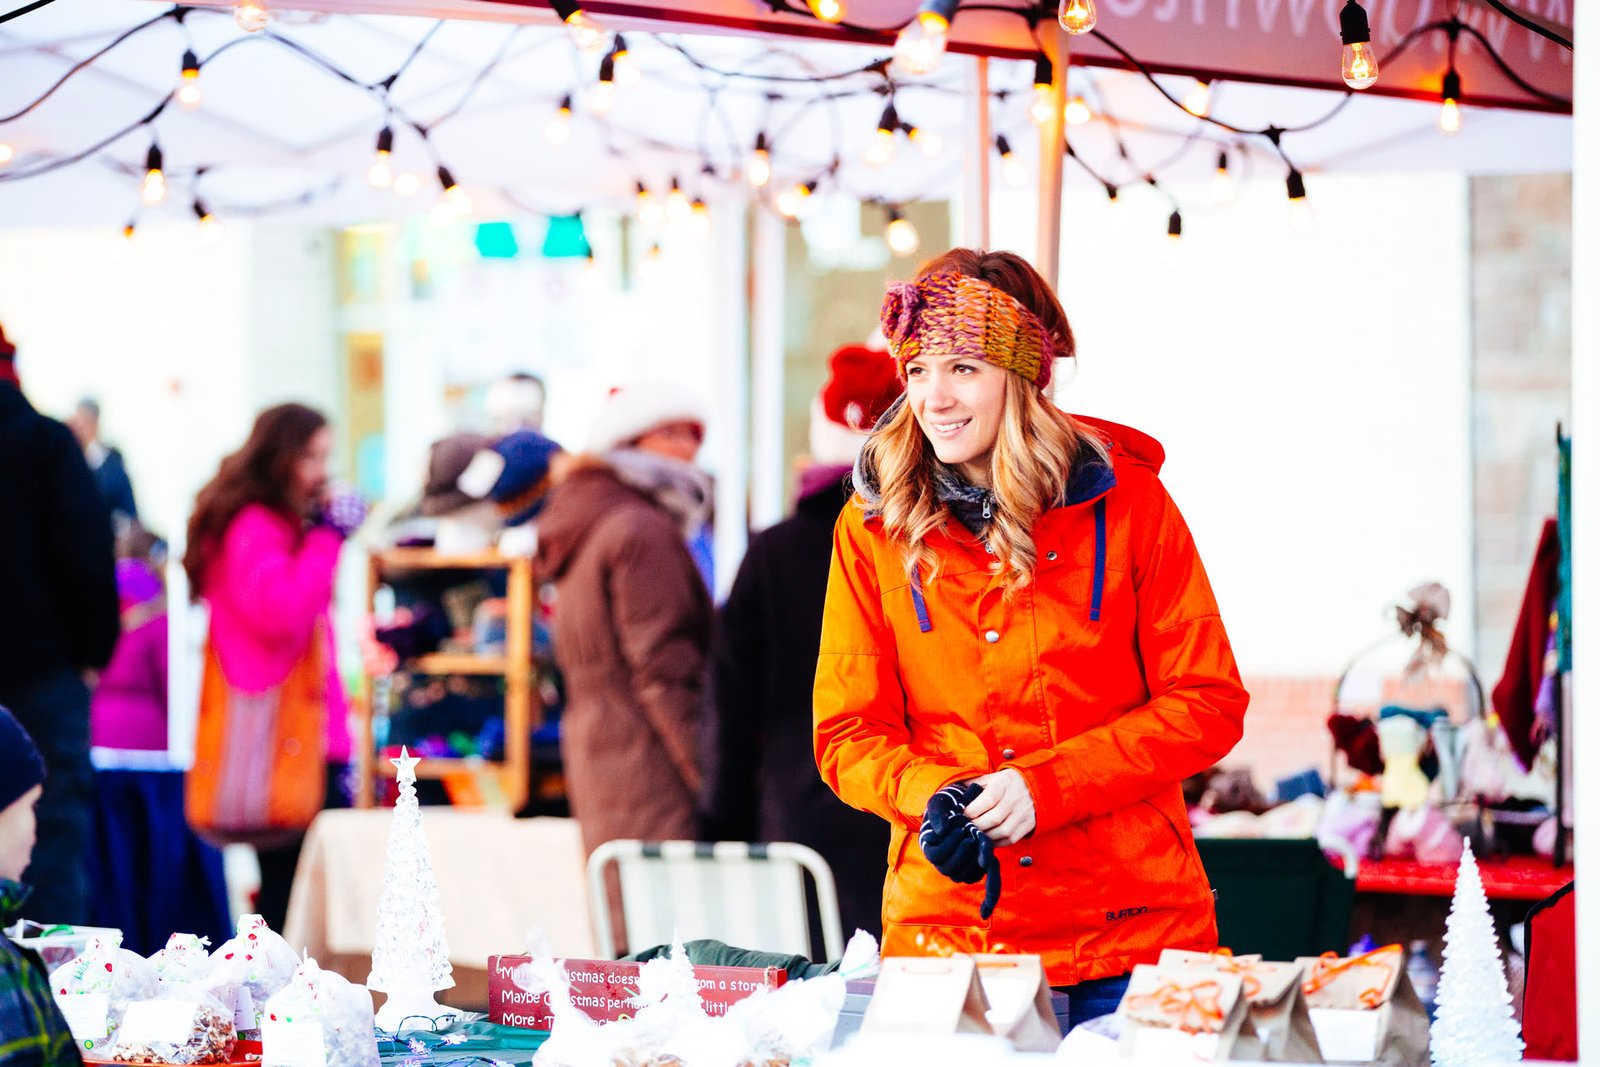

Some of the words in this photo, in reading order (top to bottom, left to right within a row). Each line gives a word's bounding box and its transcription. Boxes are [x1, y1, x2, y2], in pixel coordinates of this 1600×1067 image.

[1106, 905, 1148, 921] BURTON
[719, 980, 727, 990] a
[502, 989, 540, 1004] Maybe
[706, 1000, 728, 1014] littl
[502, 1012, 535, 1027] More
